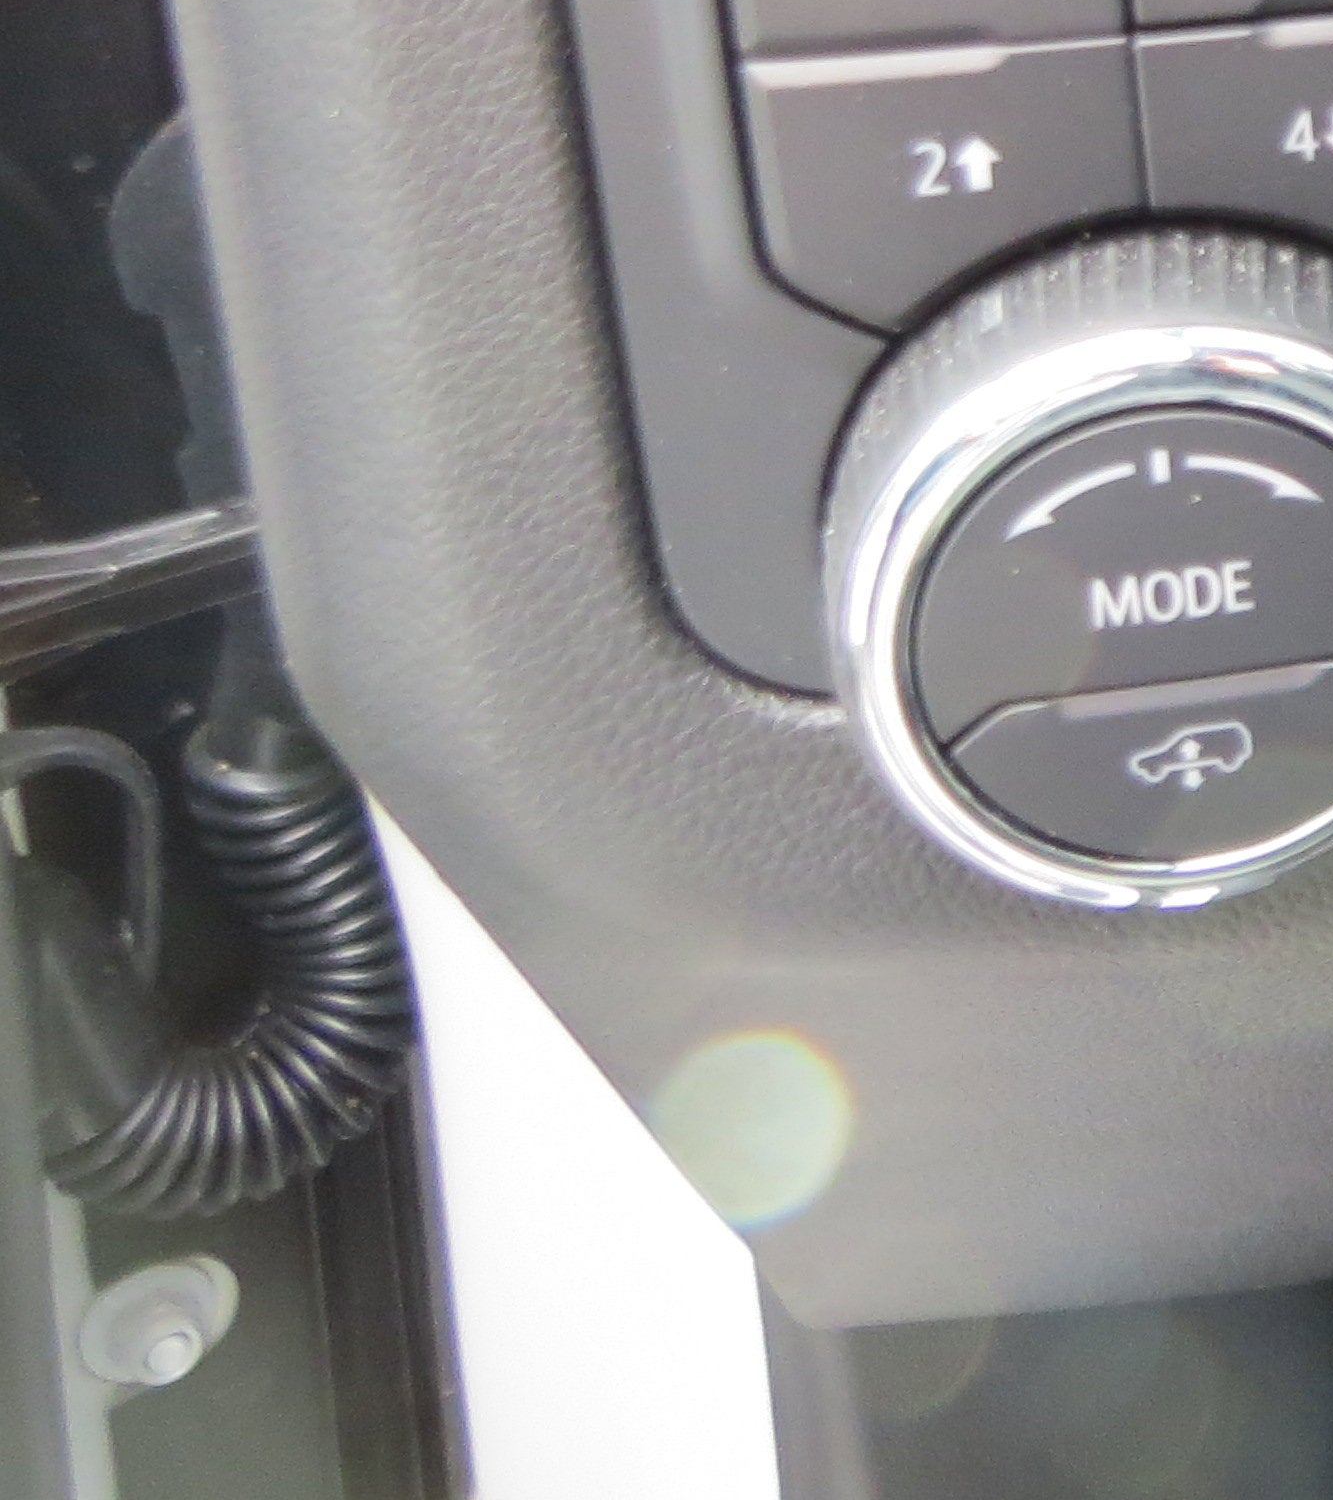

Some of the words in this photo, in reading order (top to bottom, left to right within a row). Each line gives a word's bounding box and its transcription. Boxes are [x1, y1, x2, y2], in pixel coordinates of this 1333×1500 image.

[1283, 110, 1320, 162] 4
[912, 142, 950, 198] 2
[1087, 560, 1256, 630] MODE
